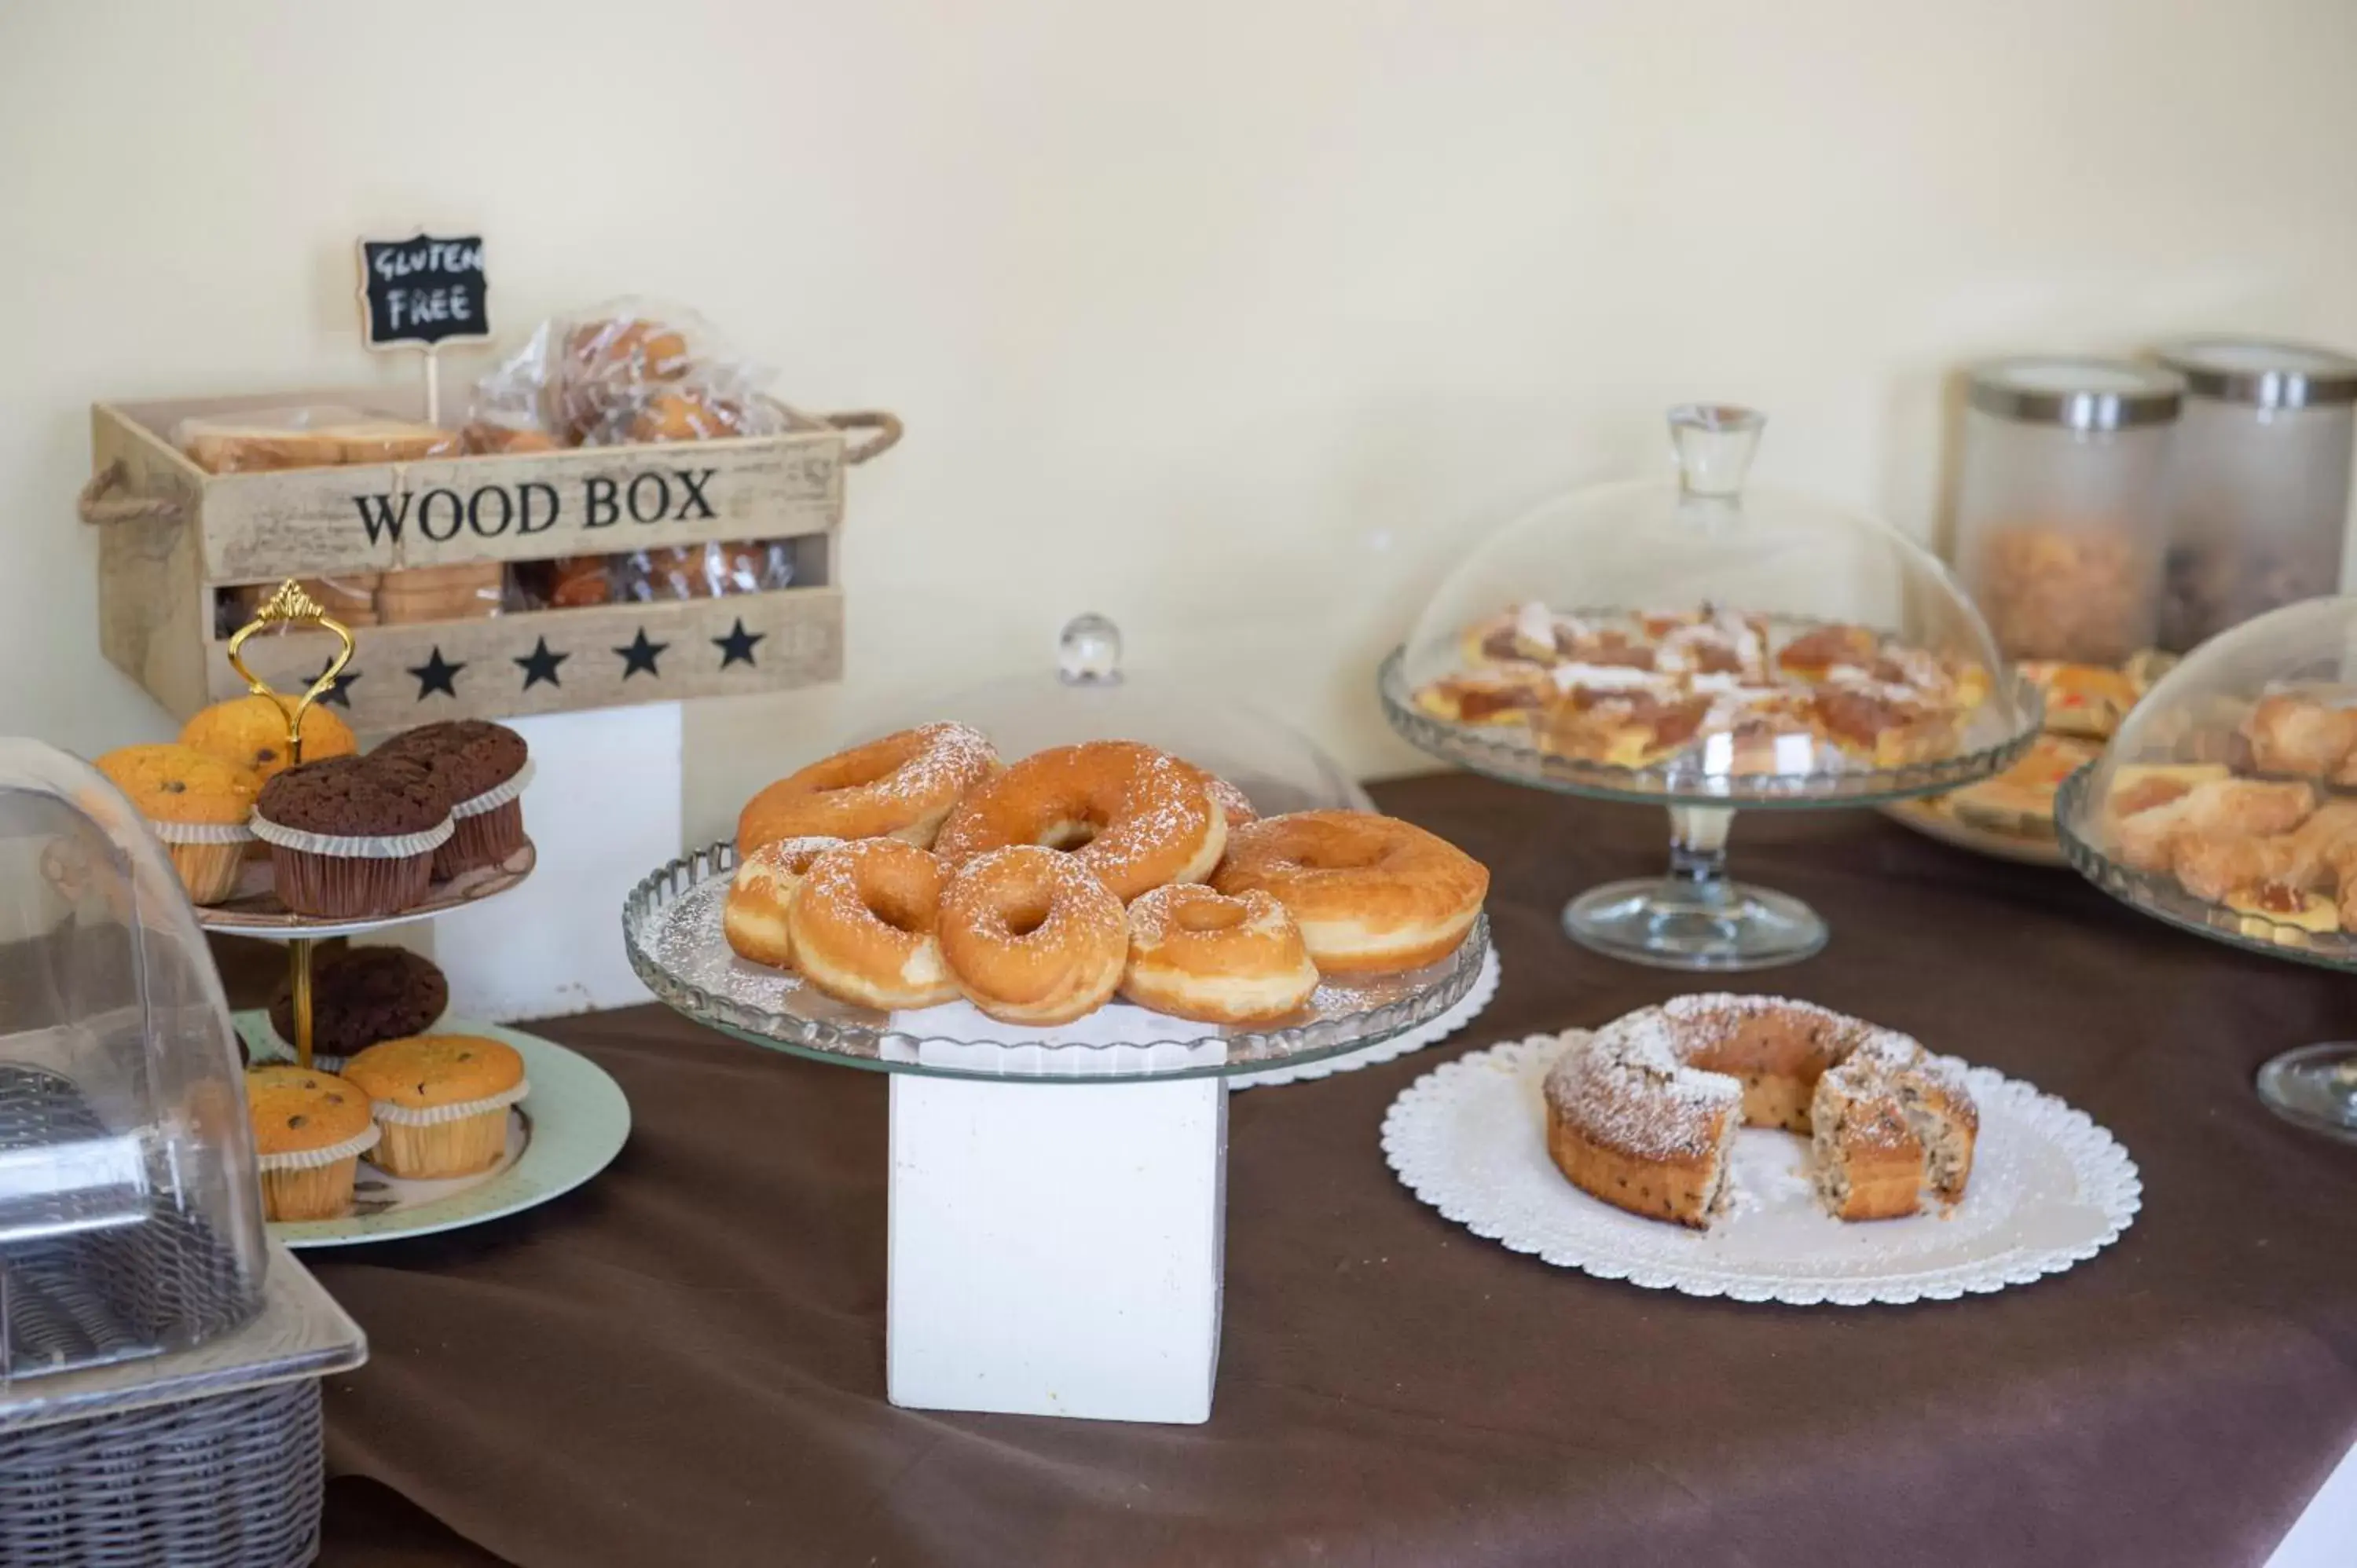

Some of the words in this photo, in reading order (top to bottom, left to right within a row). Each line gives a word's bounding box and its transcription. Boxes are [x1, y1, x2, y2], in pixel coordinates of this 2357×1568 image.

[374, 243, 484, 281] GLUTEN
[386, 284, 471, 331] FREE
[353, 482, 559, 546] WOOD
[582, 469, 717, 529] BOX
